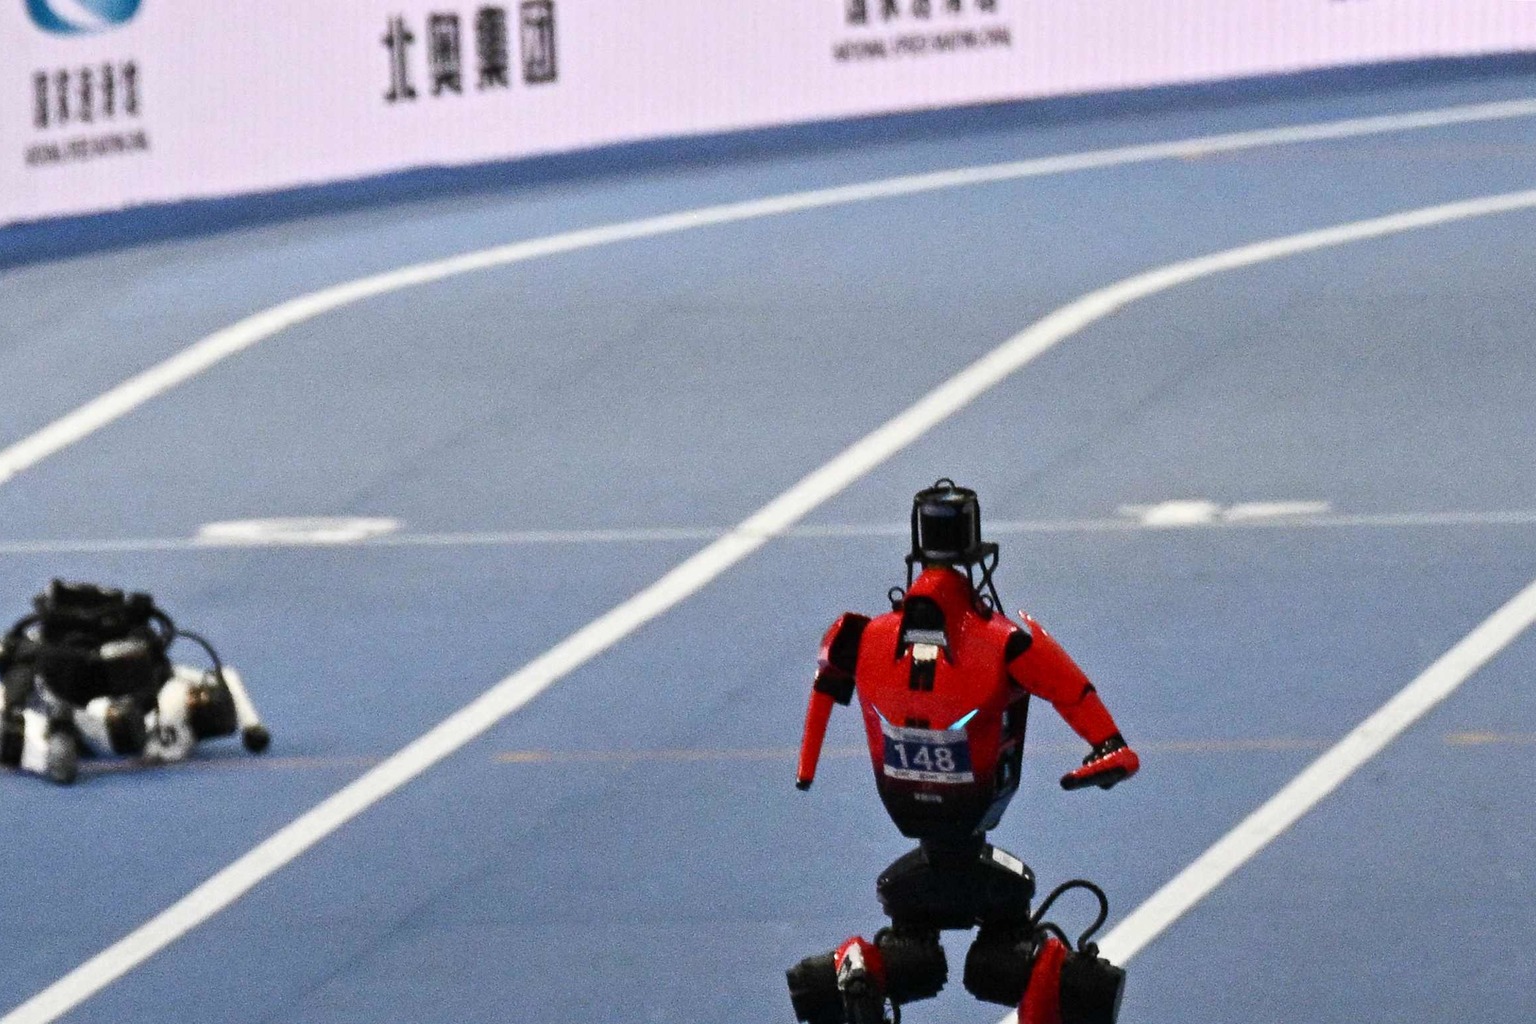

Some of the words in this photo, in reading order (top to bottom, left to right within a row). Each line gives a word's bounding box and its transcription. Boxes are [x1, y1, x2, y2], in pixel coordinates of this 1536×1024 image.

[382, 0, 558, 104] 北奥集团
[894, 743, 955, 772] 148
